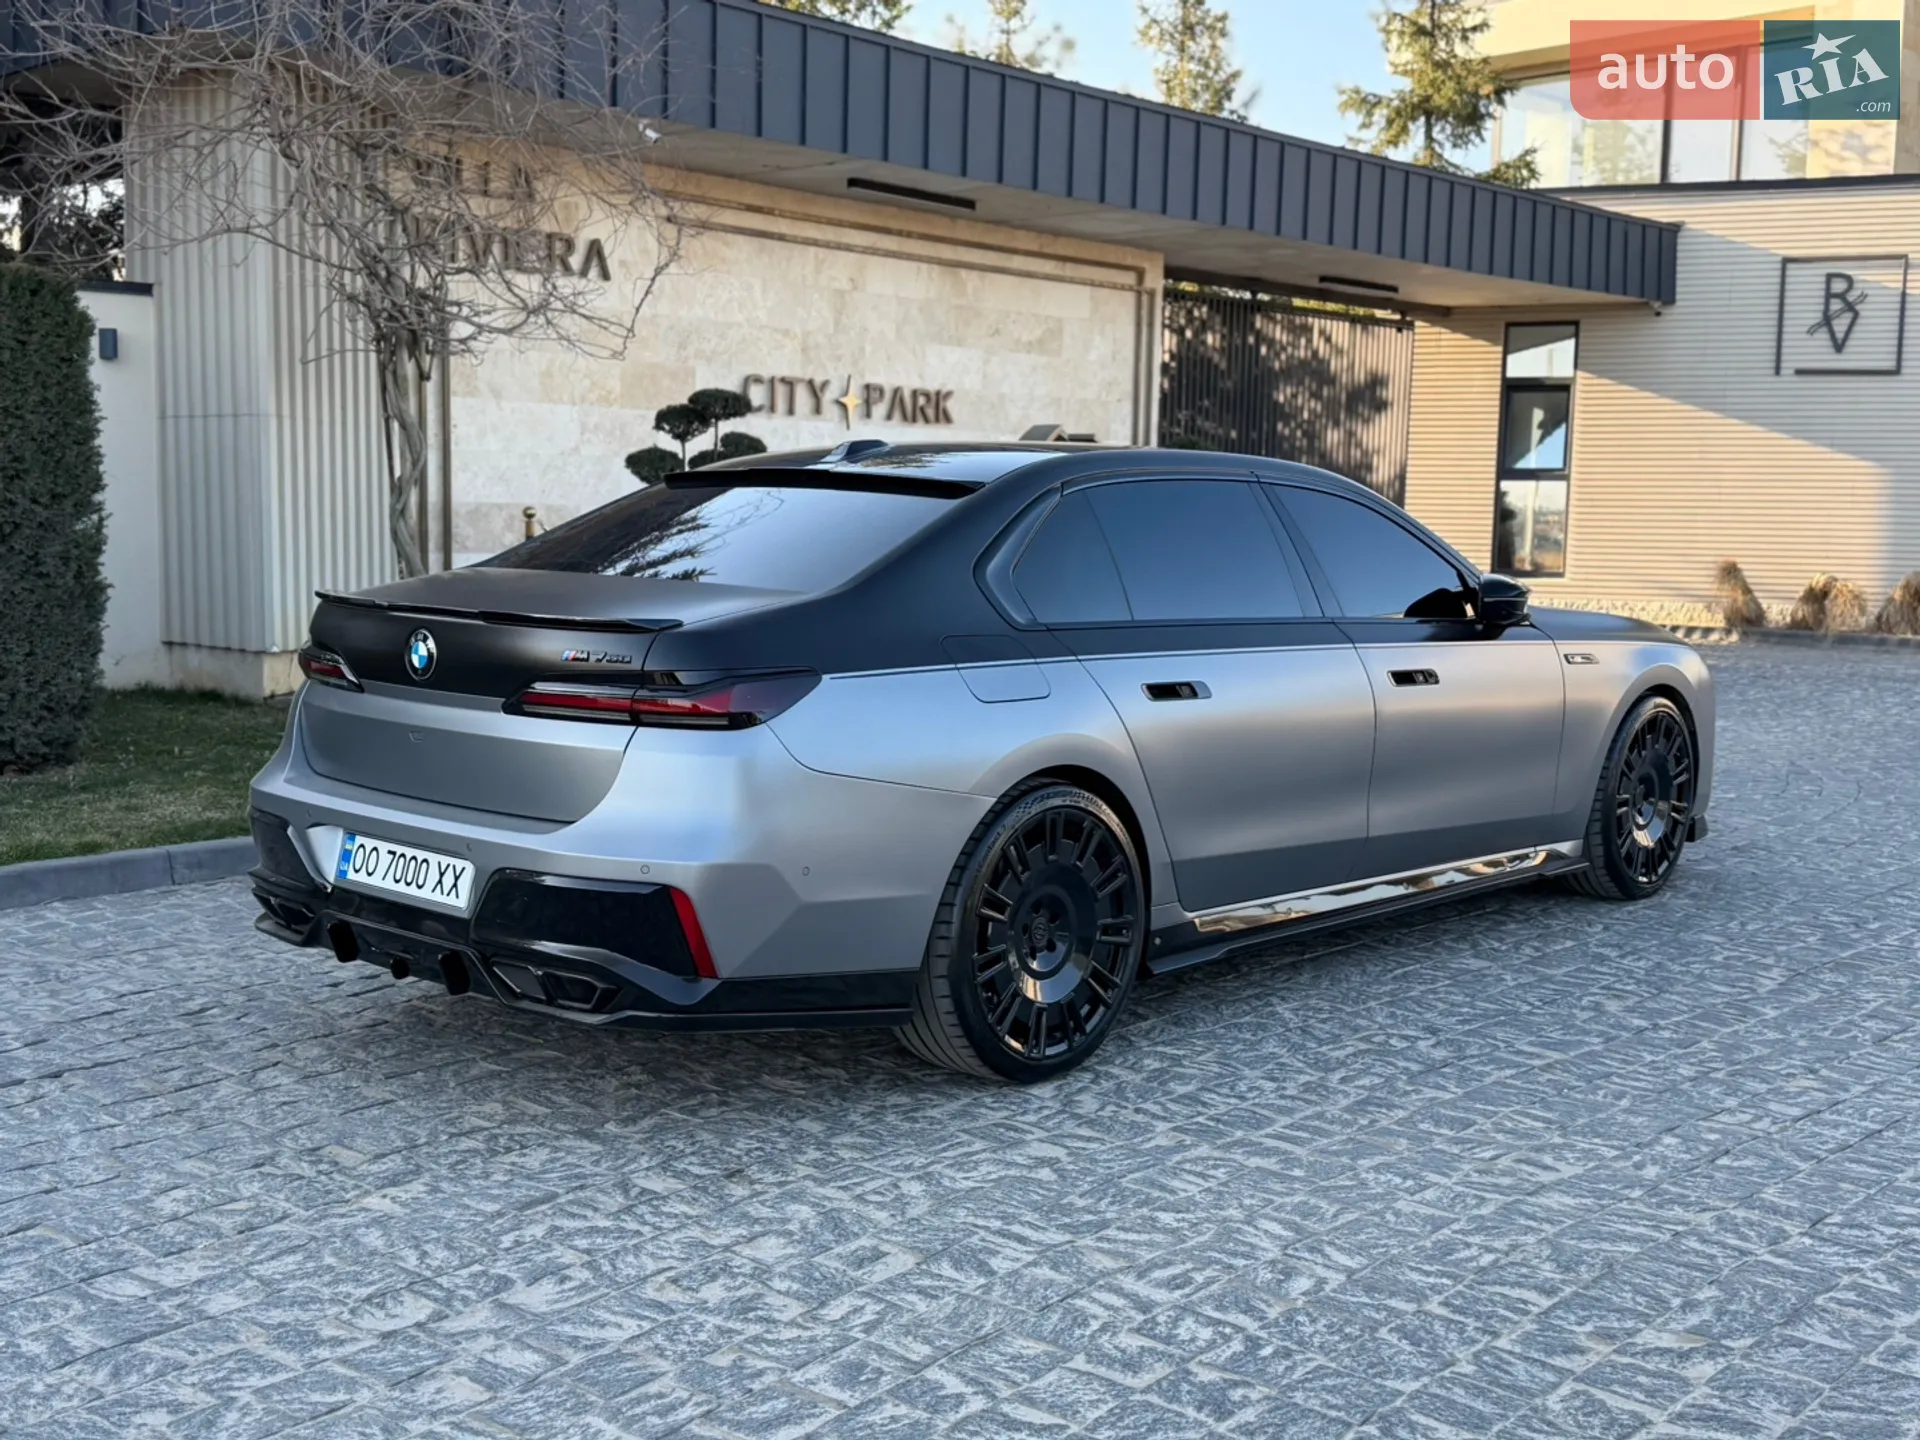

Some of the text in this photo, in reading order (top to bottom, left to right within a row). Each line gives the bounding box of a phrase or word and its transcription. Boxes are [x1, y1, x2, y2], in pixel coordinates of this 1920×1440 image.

[743, 373, 955, 424] CITY PARK
[353, 843, 467, 899] OO 7000 XX
